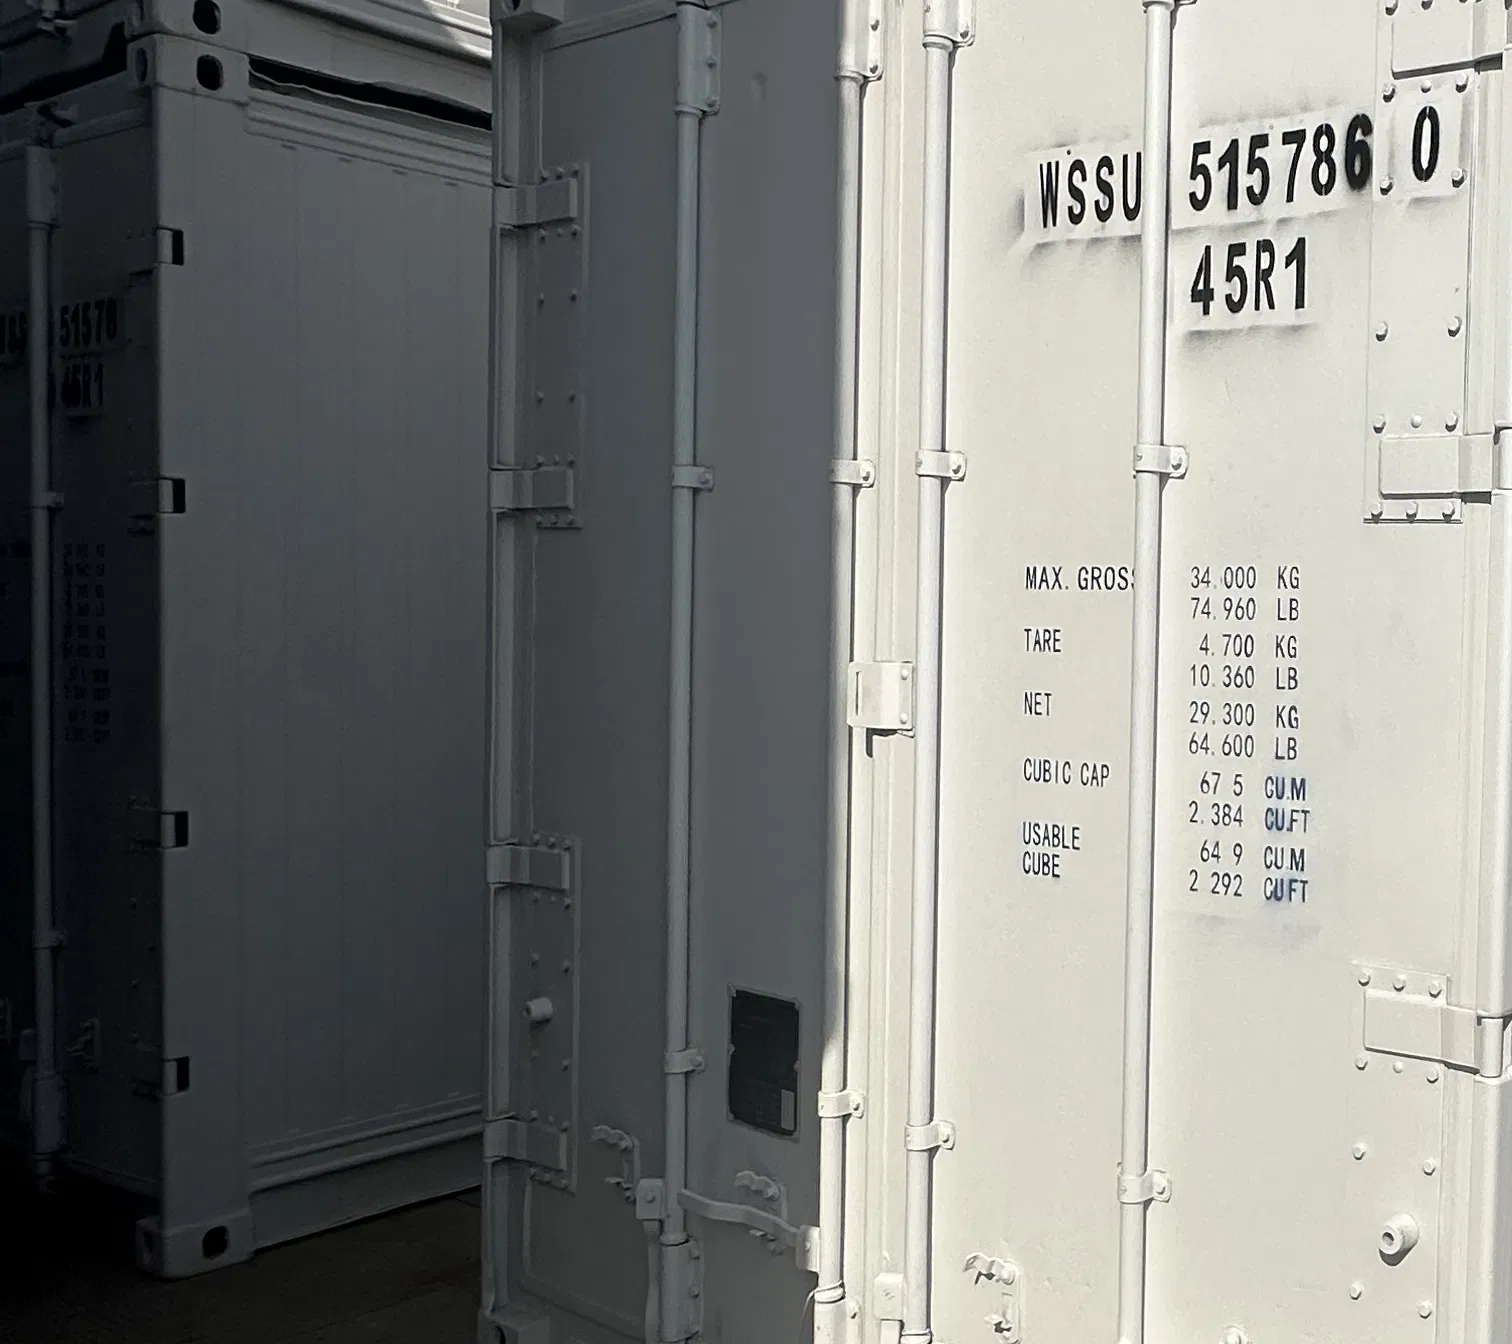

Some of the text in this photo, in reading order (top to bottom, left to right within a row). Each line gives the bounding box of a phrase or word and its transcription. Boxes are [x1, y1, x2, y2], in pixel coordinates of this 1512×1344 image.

[1039, 105, 1440, 228] WSSU 515786 0
[1190, 236, 1307, 316] 45R1
[1025, 565, 1299, 591] MAX. GROS 34.000 KG
[1191, 596, 1299, 621] 74.960 LB
[1023, 628, 1298, 659] TARE 4.700 KG
[1190, 663, 1298, 690] 10.360 LB
[1024, 691, 1299, 730] NET 29.300 KG
[1189, 731, 1297, 760] 64.600 LB
[1023, 757, 1072, 785] CUBIC
[1080, 762, 1110, 788] CAP
[1022, 821, 1081, 850] USABLE
[1022, 850, 1061, 878] CUBE
